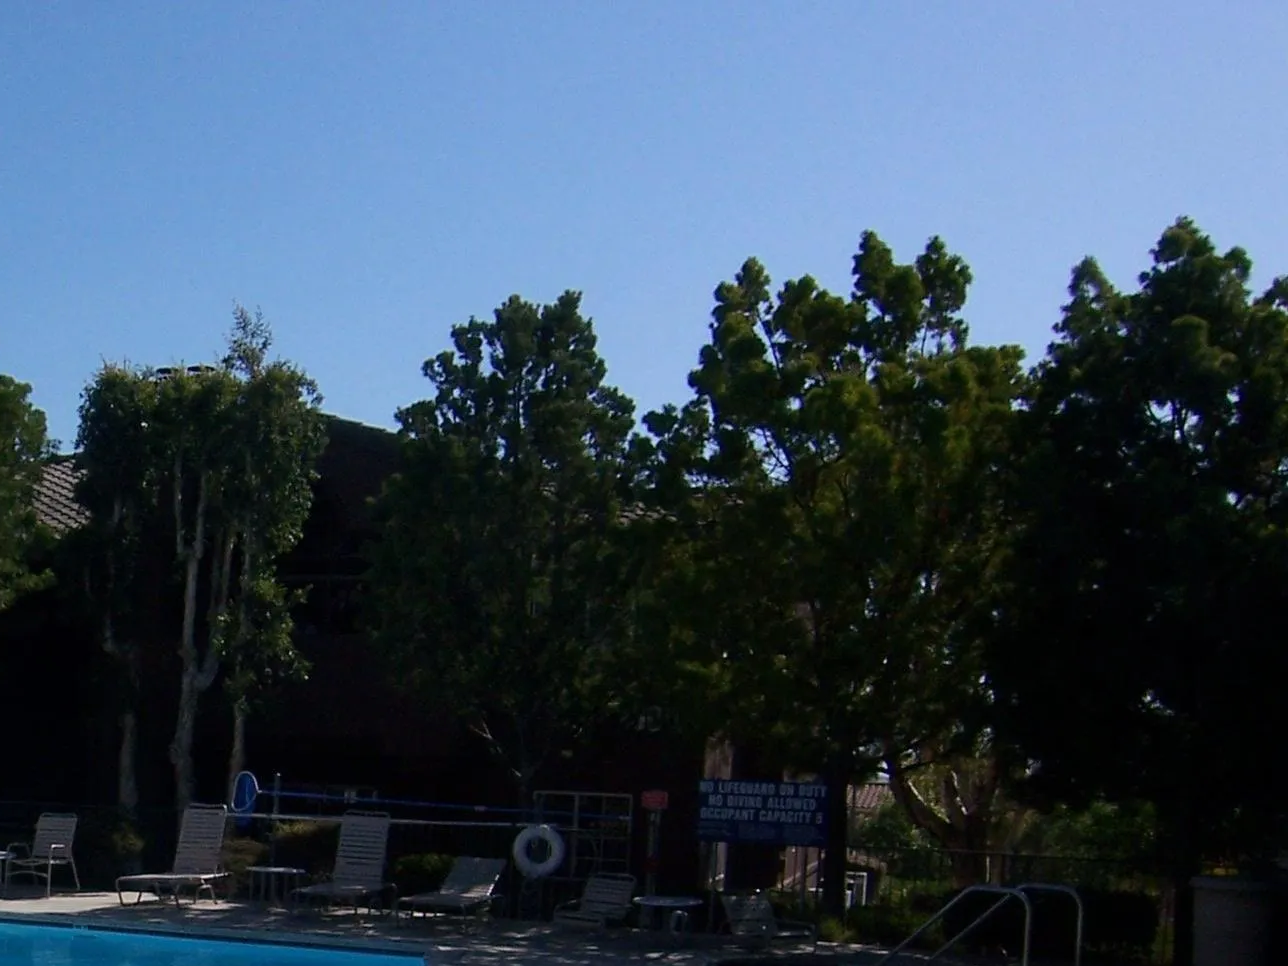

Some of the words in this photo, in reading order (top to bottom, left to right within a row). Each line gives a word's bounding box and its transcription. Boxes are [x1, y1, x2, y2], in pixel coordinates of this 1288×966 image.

[719, 782, 775, 795] LIFEGUARD
[780, 784, 794, 796] ON
[799, 785, 827, 797] DUTY
[708, 795, 723, 806] NO
[727, 796, 762, 808] DIVING
[768, 798, 816, 810] ALLOWED
[700, 808, 756, 820] OCCUPANT
[759, 810, 812, 823] CAPACITY
